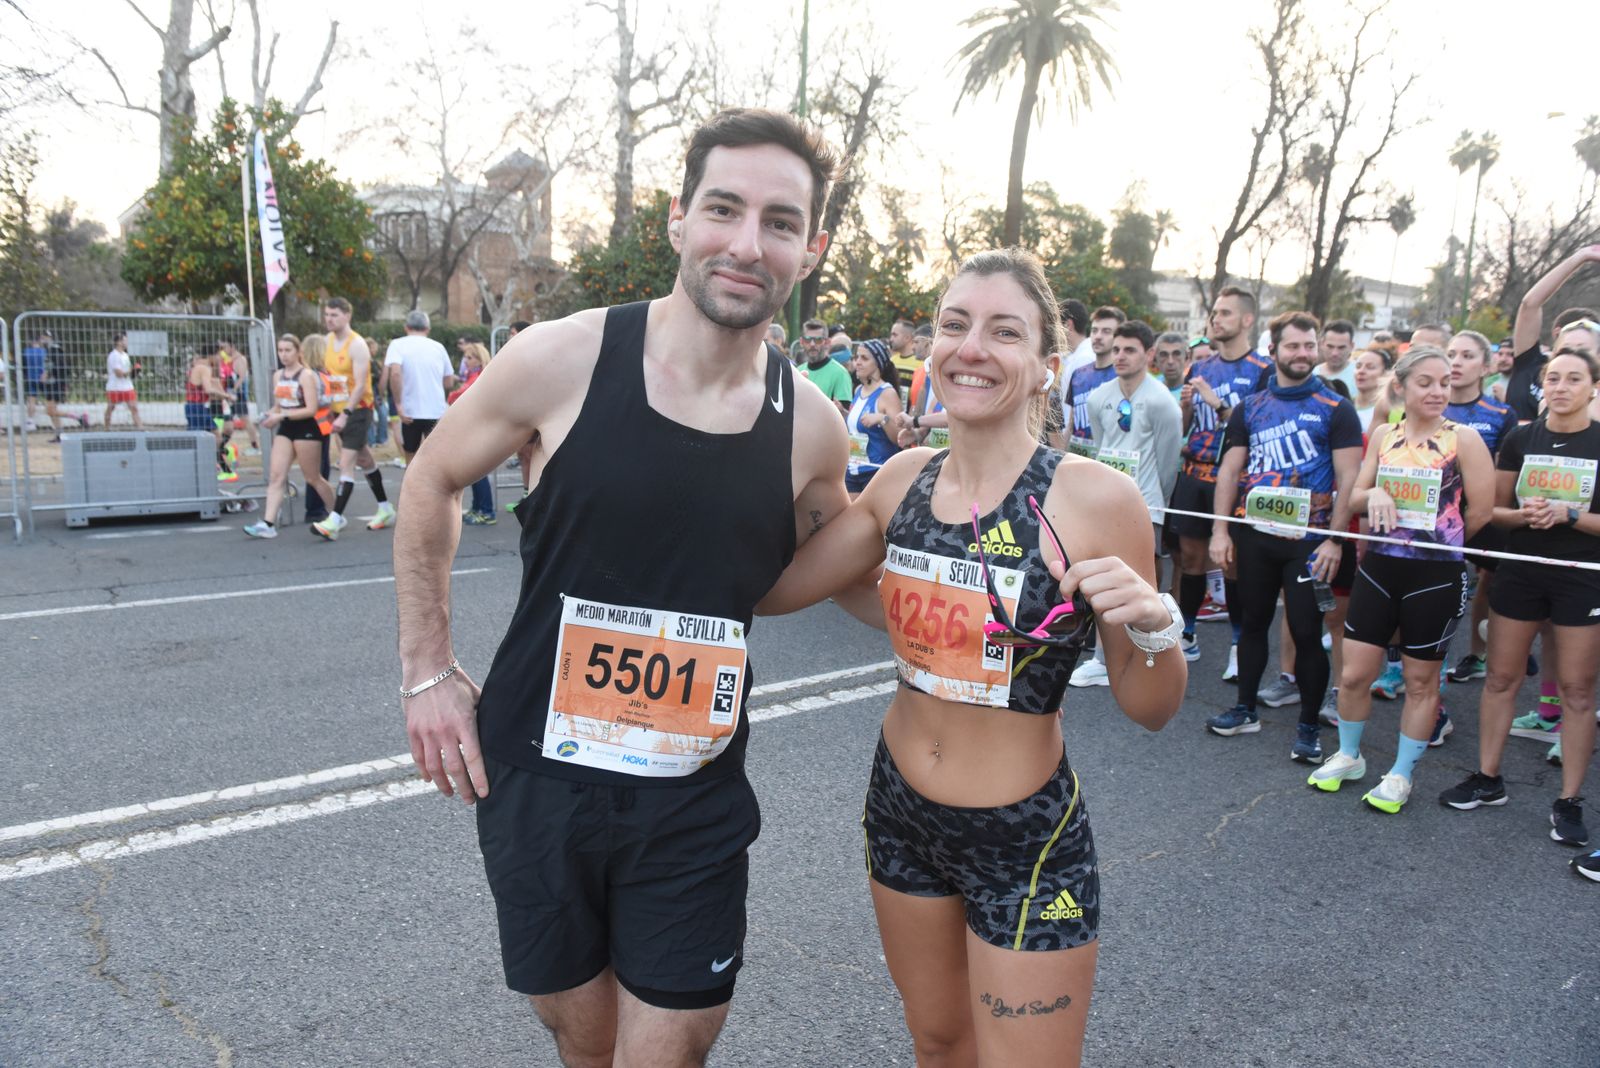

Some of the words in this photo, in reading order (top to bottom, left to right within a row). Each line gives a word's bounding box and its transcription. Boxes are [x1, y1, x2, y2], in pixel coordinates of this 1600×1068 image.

[1527, 470, 1575, 491] 6880
[1256, 496, 1294, 516] 6490
[968, 541, 1023, 558] adidas
[897, 551, 931, 573] MARATÓN
[575, 603, 605, 622] MEDIO
[607, 609, 653, 628] MARATÓN
[676, 615, 726, 643] SEVILLA
[889, 587, 970, 650] 4256
[585, 642, 697, 705] 5501
[628, 700, 648, 710] Jib's
[616, 715, 655, 731] Delplanque
[621, 754, 648, 767] HOKA
[1040, 907, 1083, 920] adidas
